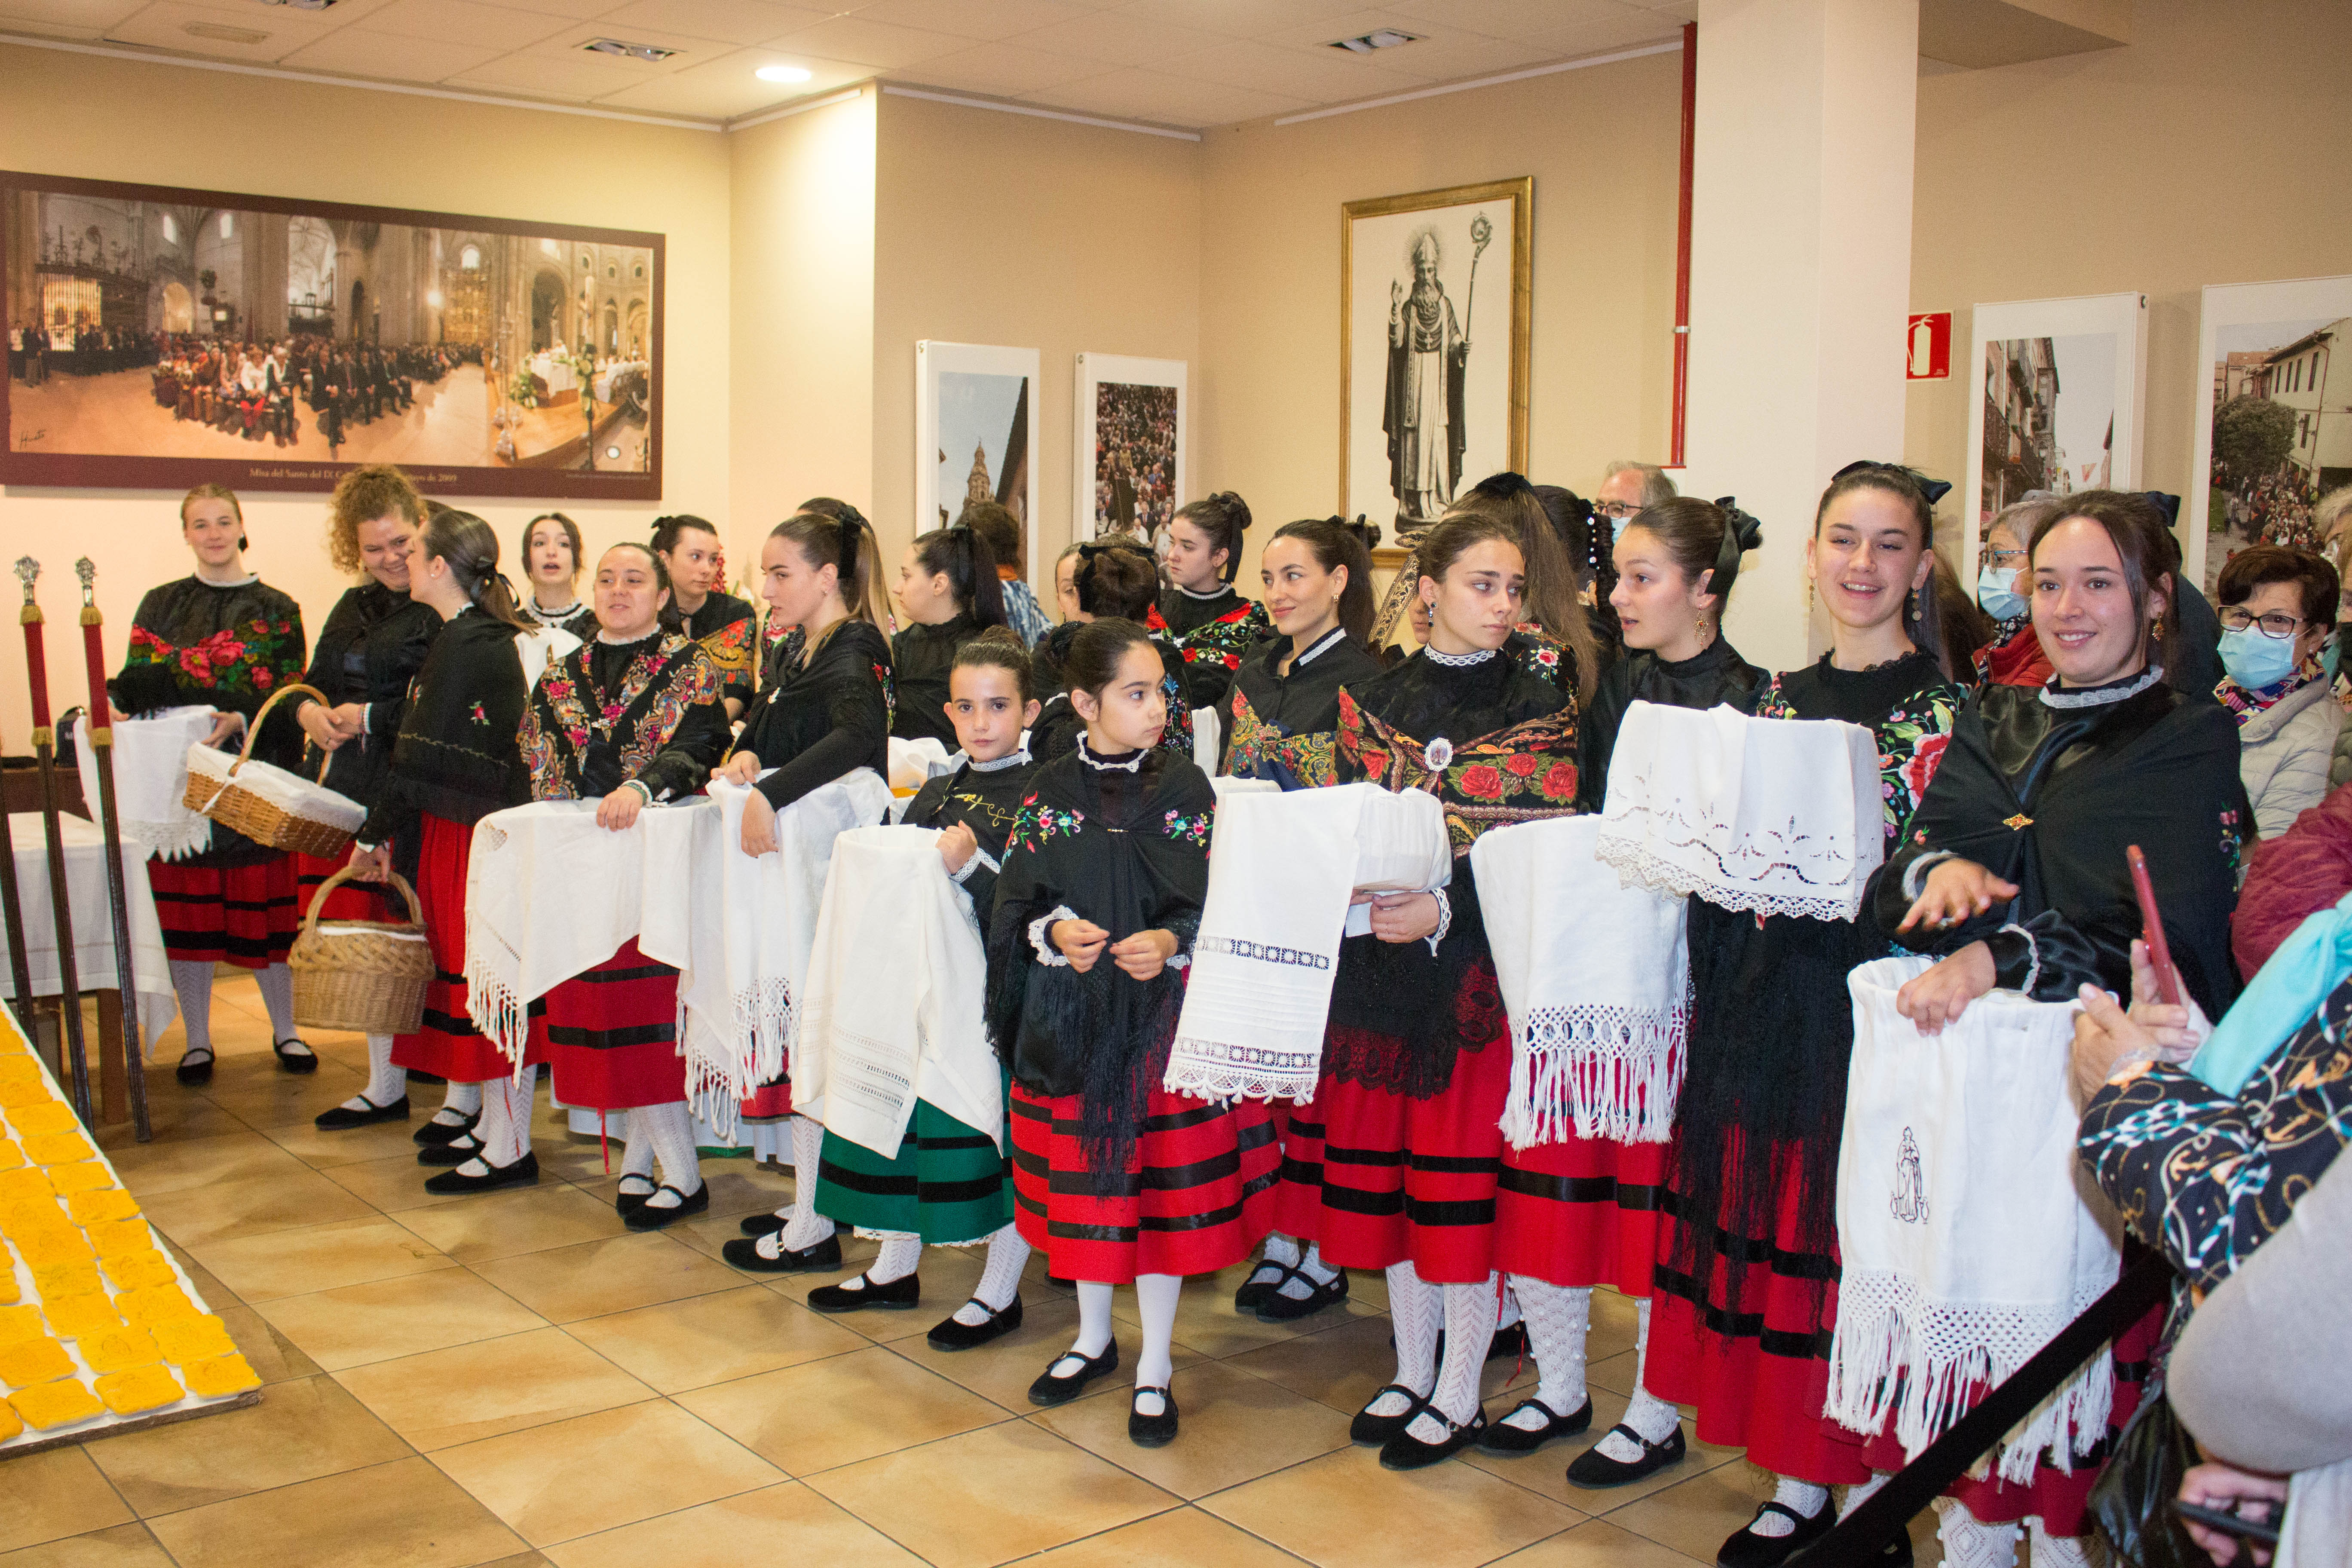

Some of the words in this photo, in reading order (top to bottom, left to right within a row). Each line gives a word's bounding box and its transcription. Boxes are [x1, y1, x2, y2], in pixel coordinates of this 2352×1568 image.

[250, 468, 269, 477] Misa
[271, 468, 284, 478] del
[285, 469, 307, 478] Santo
[309, 469, 322, 478] del
[427, 472, 437, 482] de
